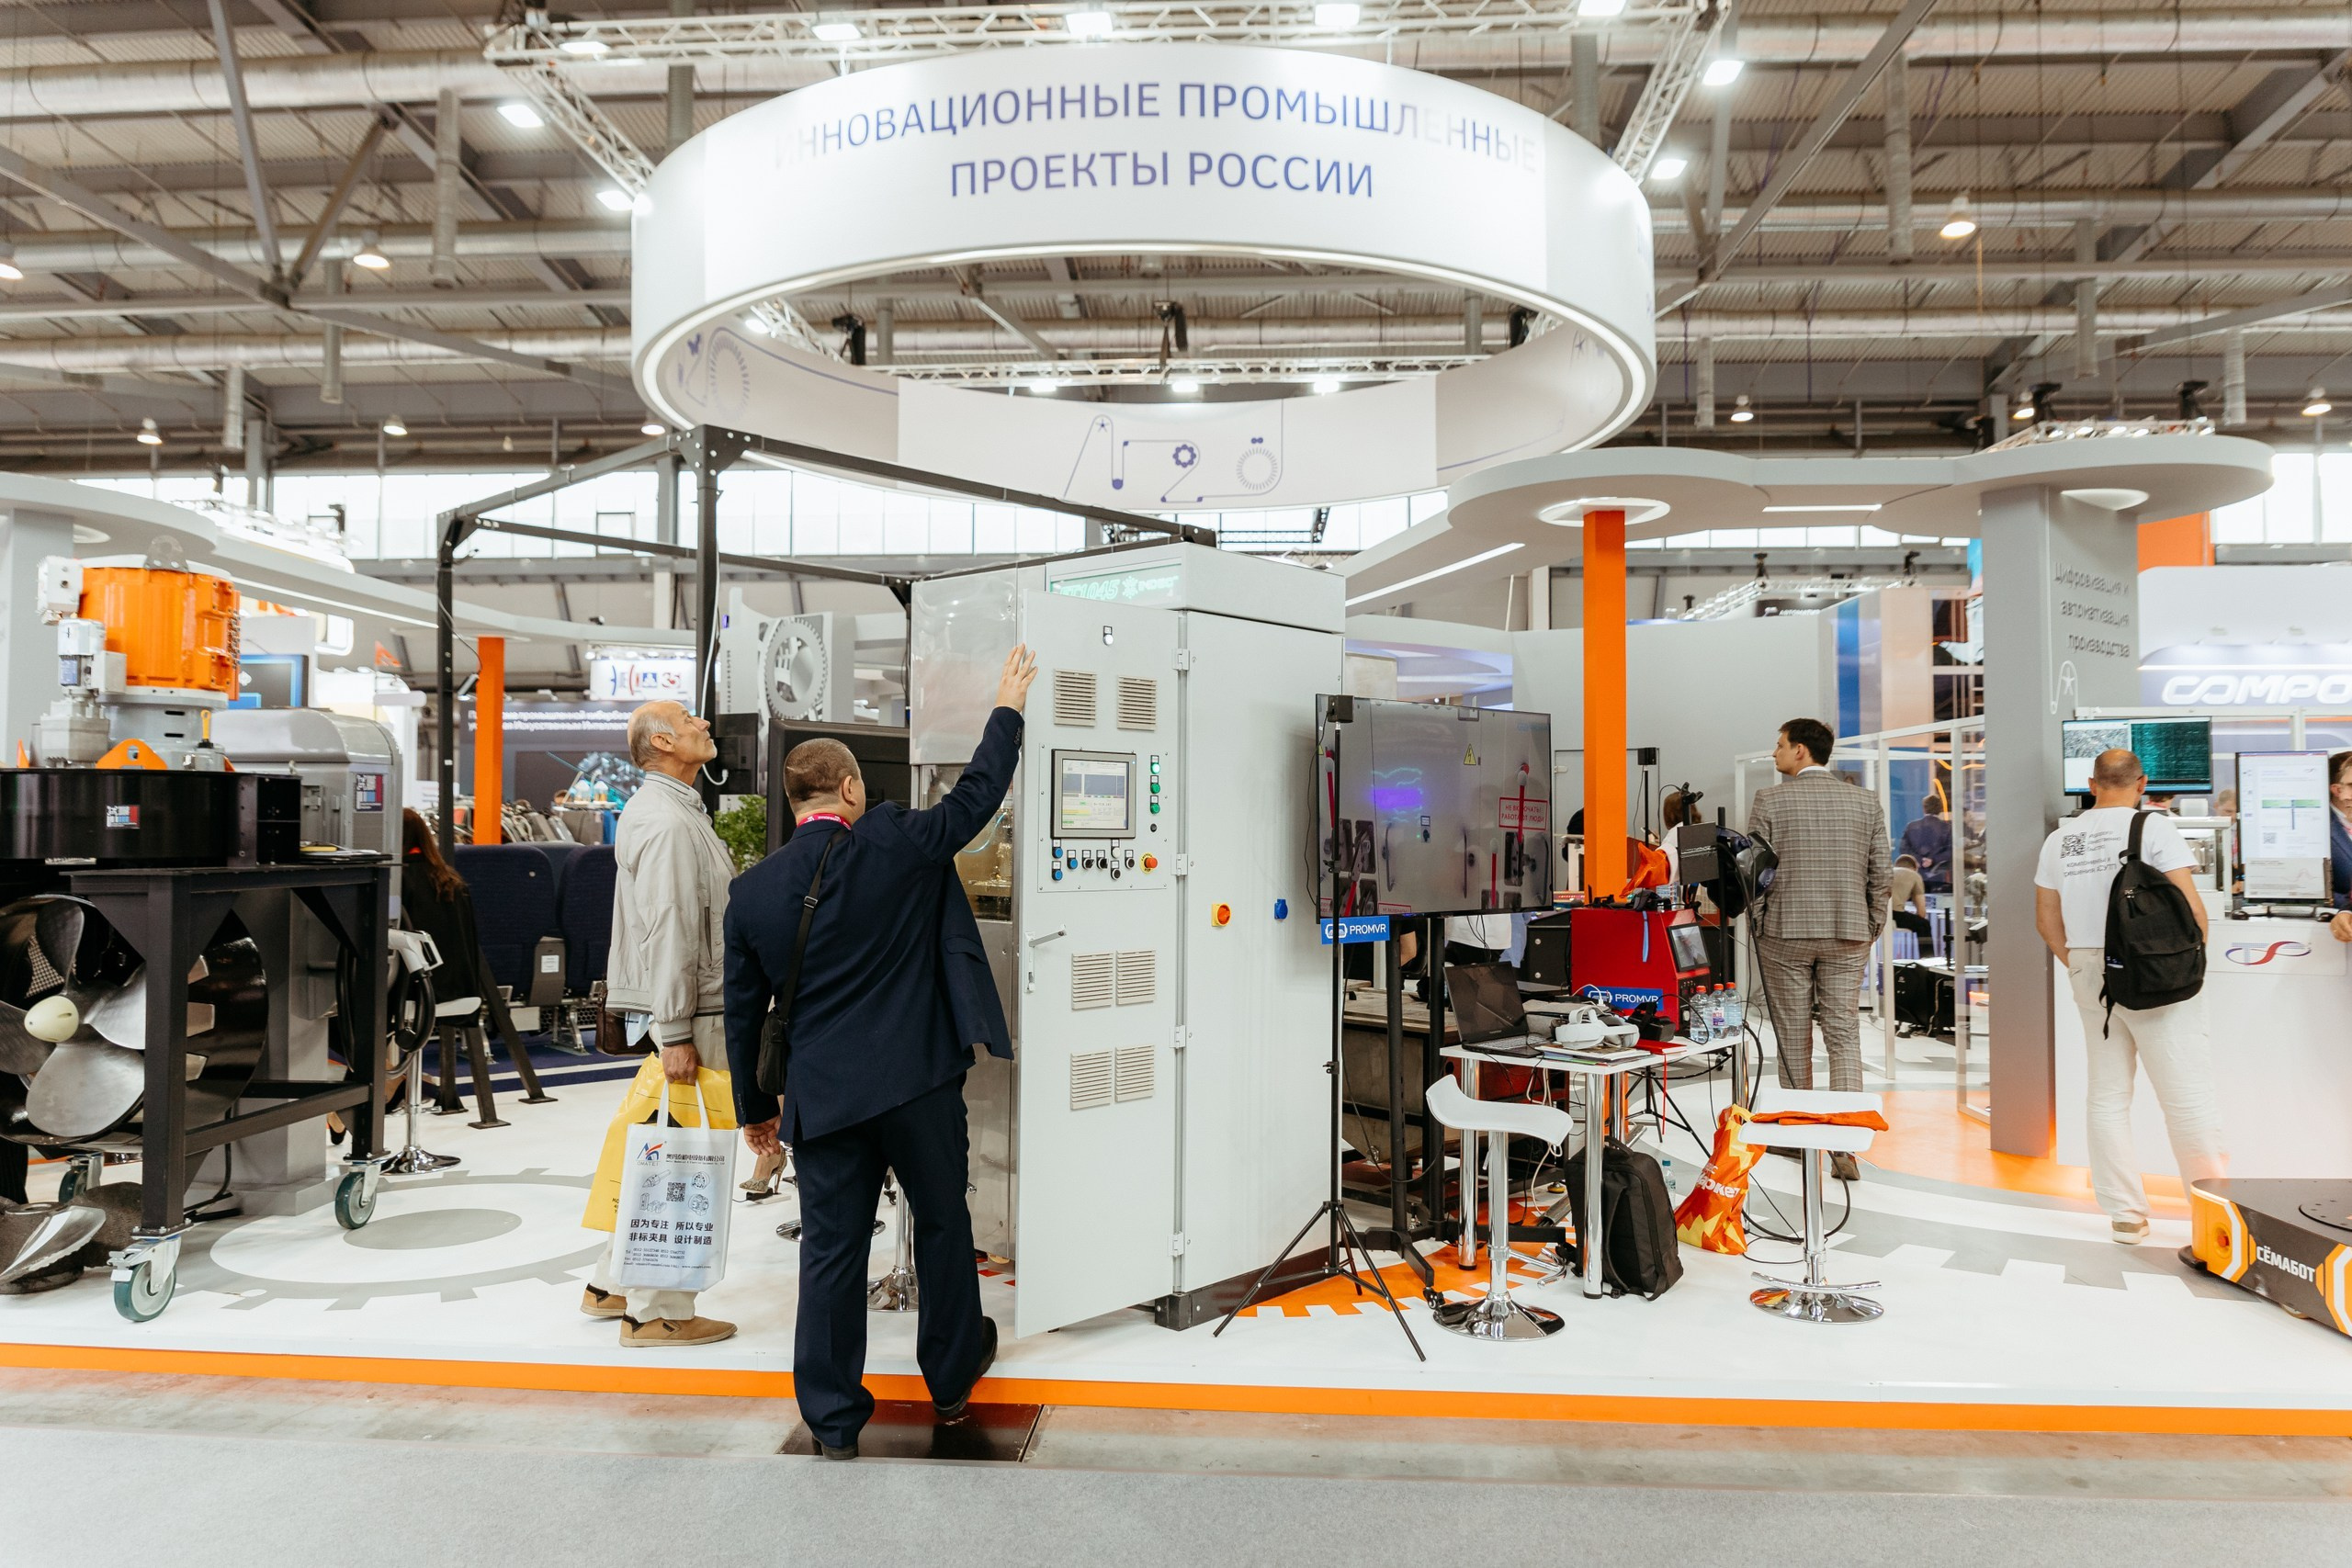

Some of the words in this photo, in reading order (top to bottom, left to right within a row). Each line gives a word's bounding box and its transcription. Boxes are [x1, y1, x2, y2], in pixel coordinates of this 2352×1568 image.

[1179, 83, 1538, 174] ПРОМЫШЛЕННЫЕ
[951, 152, 1168, 197] ПРОЕКТЫ
[1189, 152, 1374, 198] РОССИИ
[2054, 562, 2121, 595] Цифровизация
[2060, 600, 2130, 627] автоматизация
[2068, 634, 2131, 658] производства
[1349, 923, 1386, 935] PROMVR
[1614, 993, 1659, 1005] PROMVR
[630, 1218, 670, 1230] 因为专注
[675, 1221, 714, 1232] 所以专业
[628, 1232, 668, 1243] 非标夹具
[674, 1235, 713, 1246] 设计制造
[2256, 1245, 2316, 1283] СЁМАБОТ
